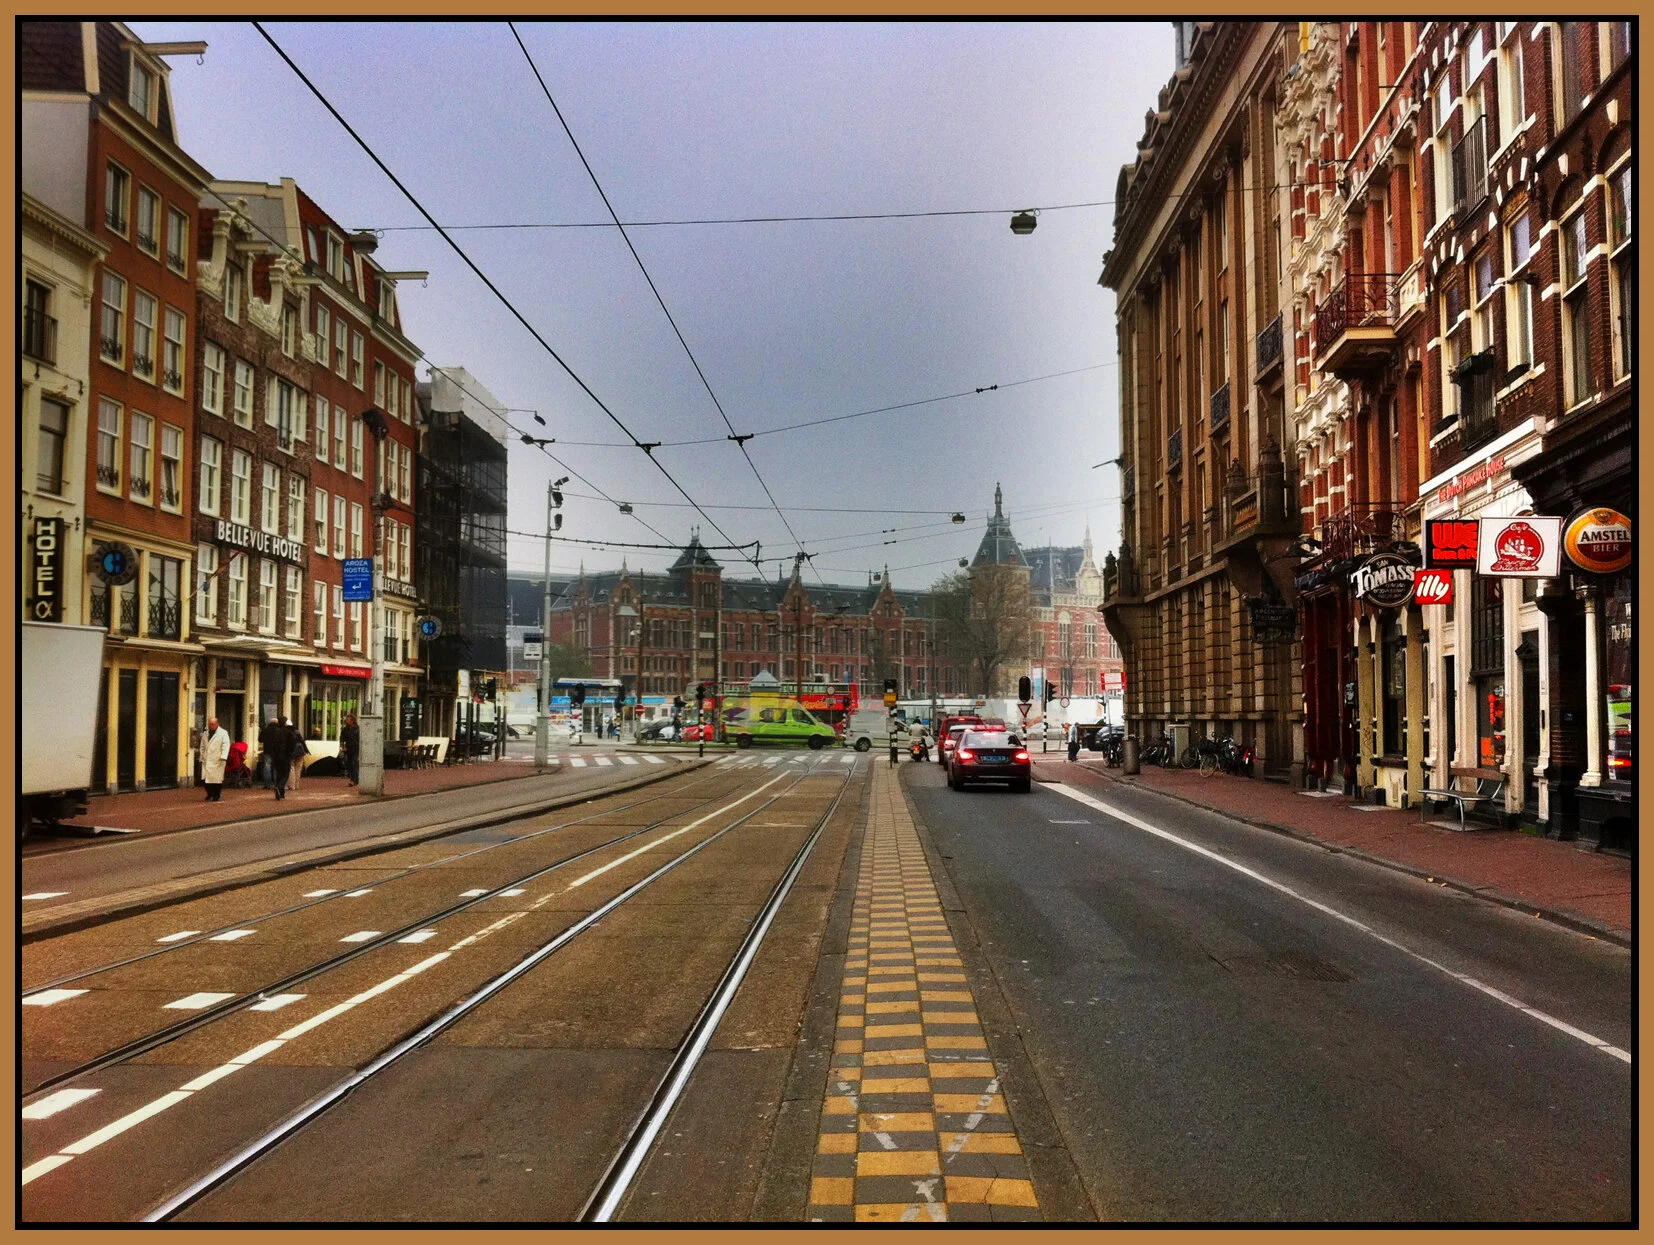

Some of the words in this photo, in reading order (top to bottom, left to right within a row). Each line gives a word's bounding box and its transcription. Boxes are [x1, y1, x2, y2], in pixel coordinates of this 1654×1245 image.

[218, 520, 270, 553] BELLEVUE
[272, 536, 302, 562] HOTEL
[1580, 529, 1630, 542] AMSTEL
[1593, 543, 1620, 552] BIER
[36, 520, 56, 596] HOTEL
[1350, 564, 1422, 599] TOMASS
[1416, 574, 1450, 602] illy
